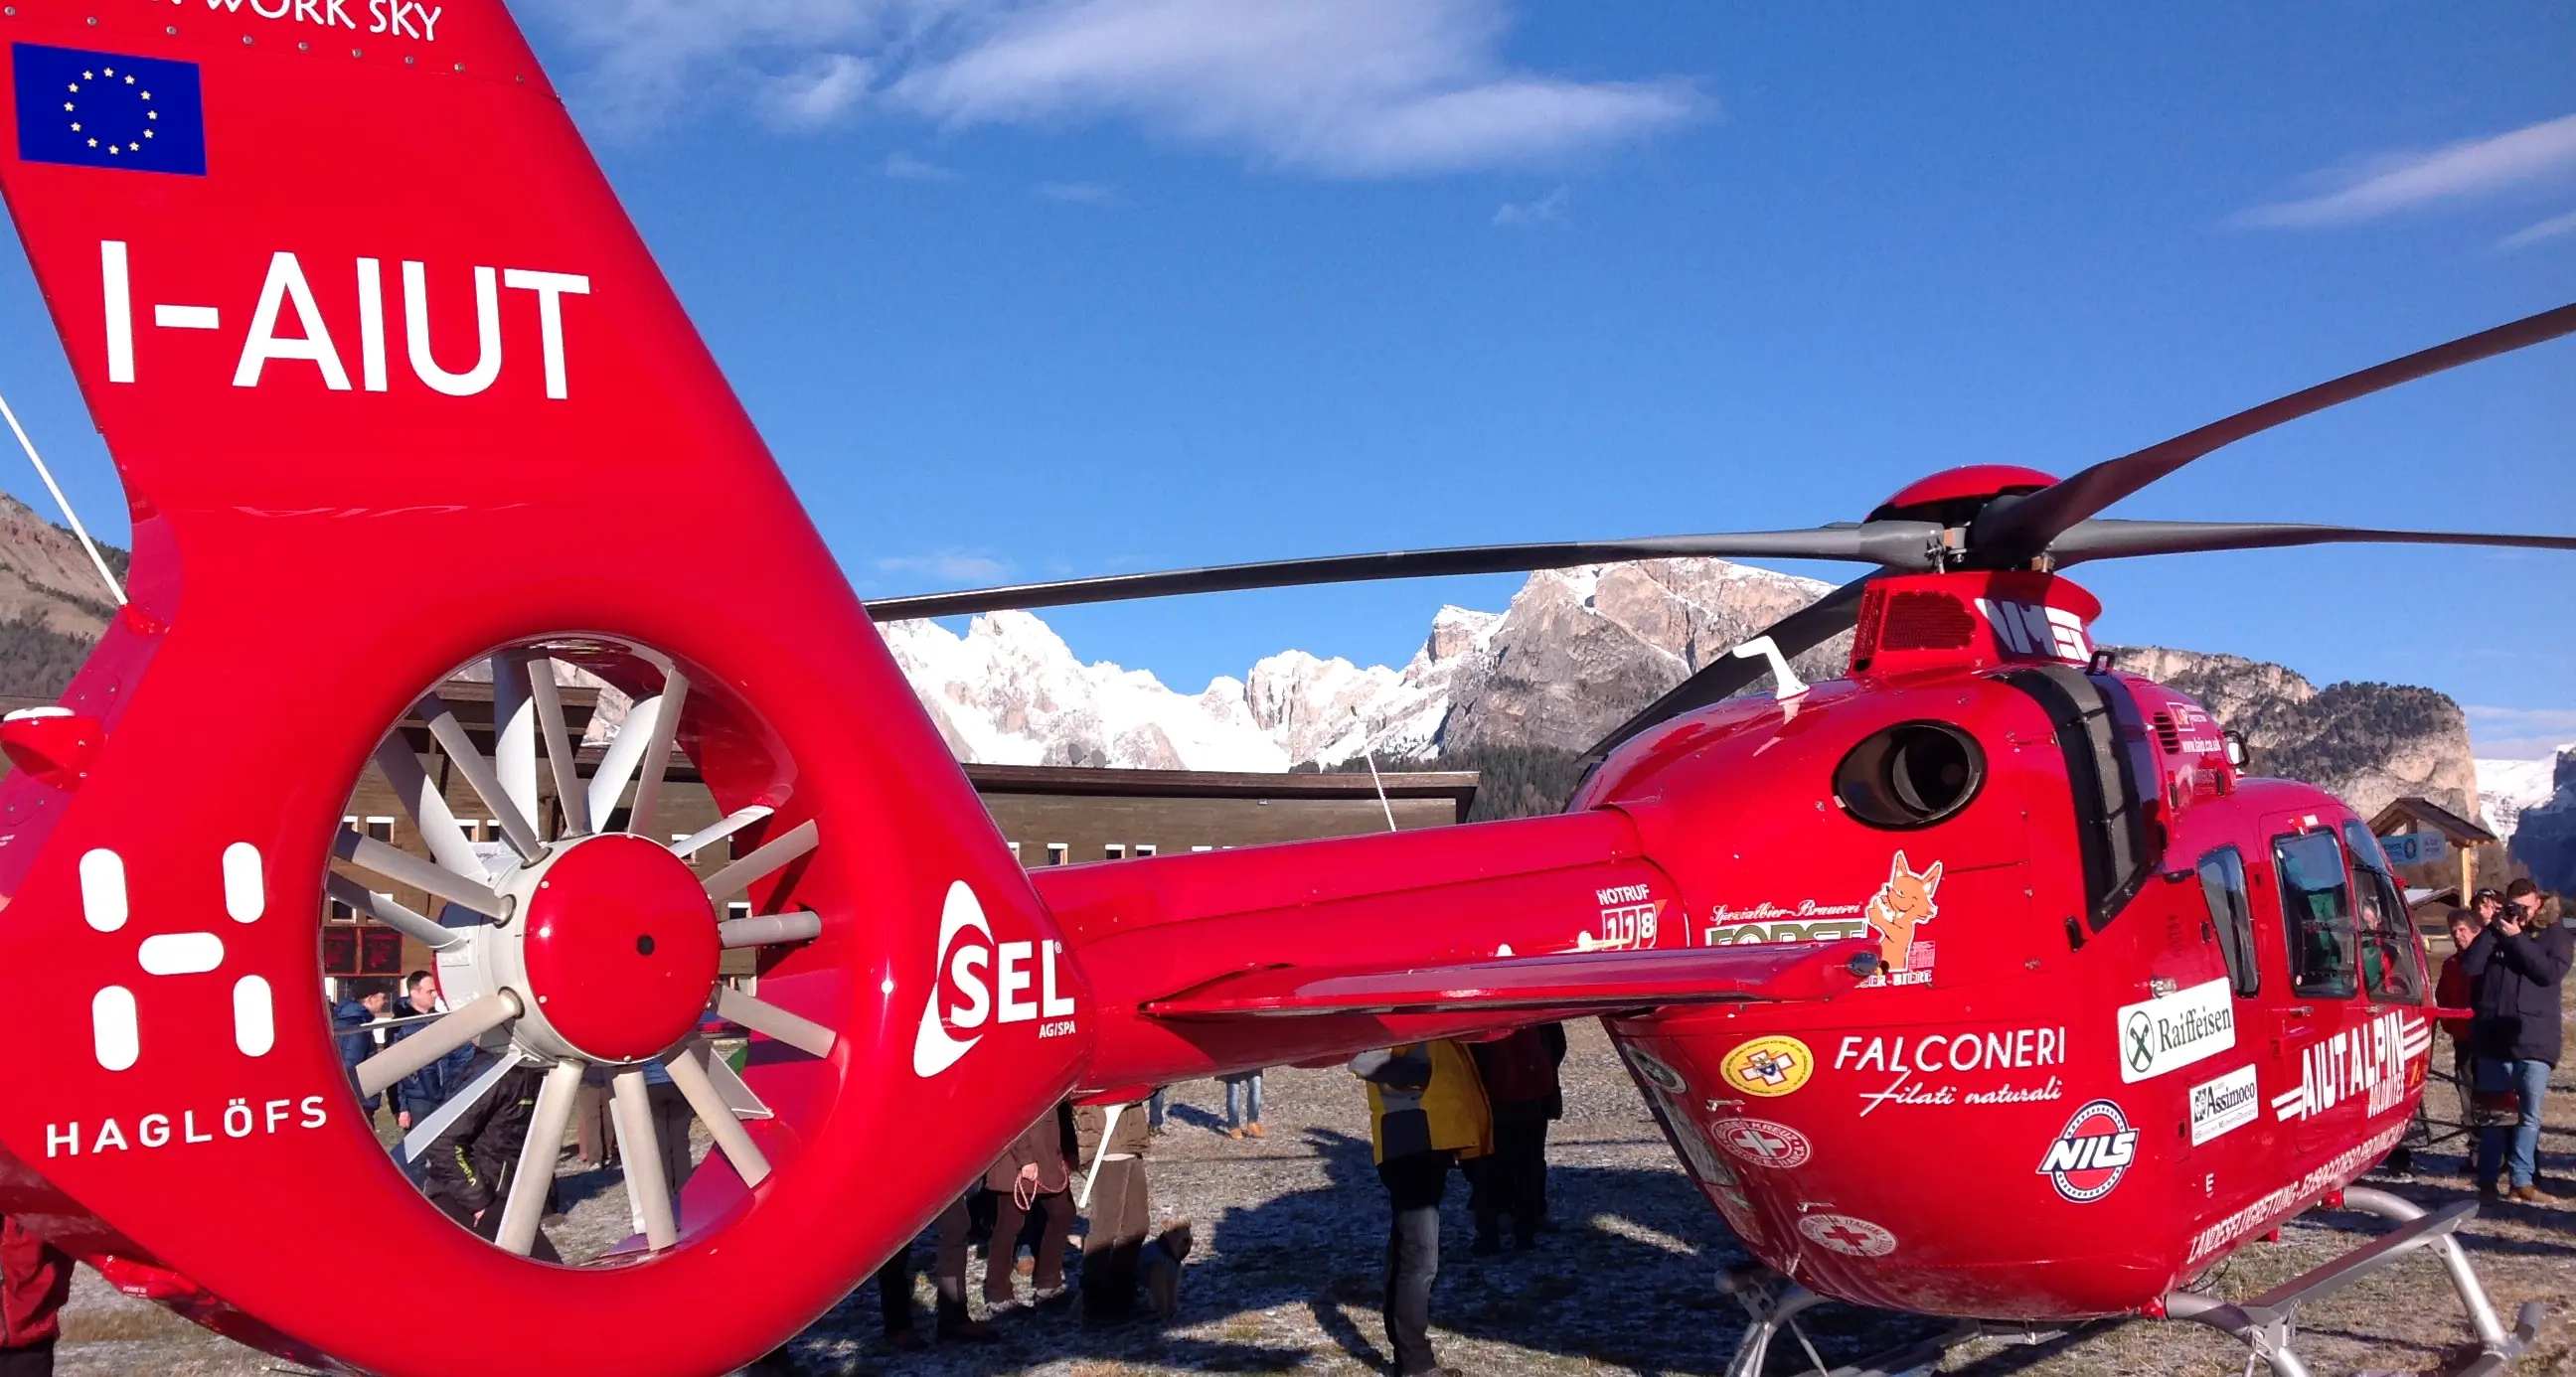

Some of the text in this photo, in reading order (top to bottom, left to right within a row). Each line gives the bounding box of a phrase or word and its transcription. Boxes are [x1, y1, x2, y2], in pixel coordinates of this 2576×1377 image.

[369, 0, 442, 41] SKY
[101, 240, 589, 399] I-AIUT
[1595, 883, 1650, 906] NOTRUF
[1606, 912, 1656, 942] 118
[1039, 1020, 1075, 1039] AG/SPA
[2158, 1005, 2232, 1053] Raiffeisen
[1834, 1026, 2065, 1072] FALCONERI
[1964, 1075, 2063, 1104] naturali
[2206, 1082, 2256, 1119] Assimoco
[47, 1096, 327, 1157] HAGLÖFS
[2040, 1131, 2138, 1172] NILS
[2205, 1172, 2214, 1192] E
